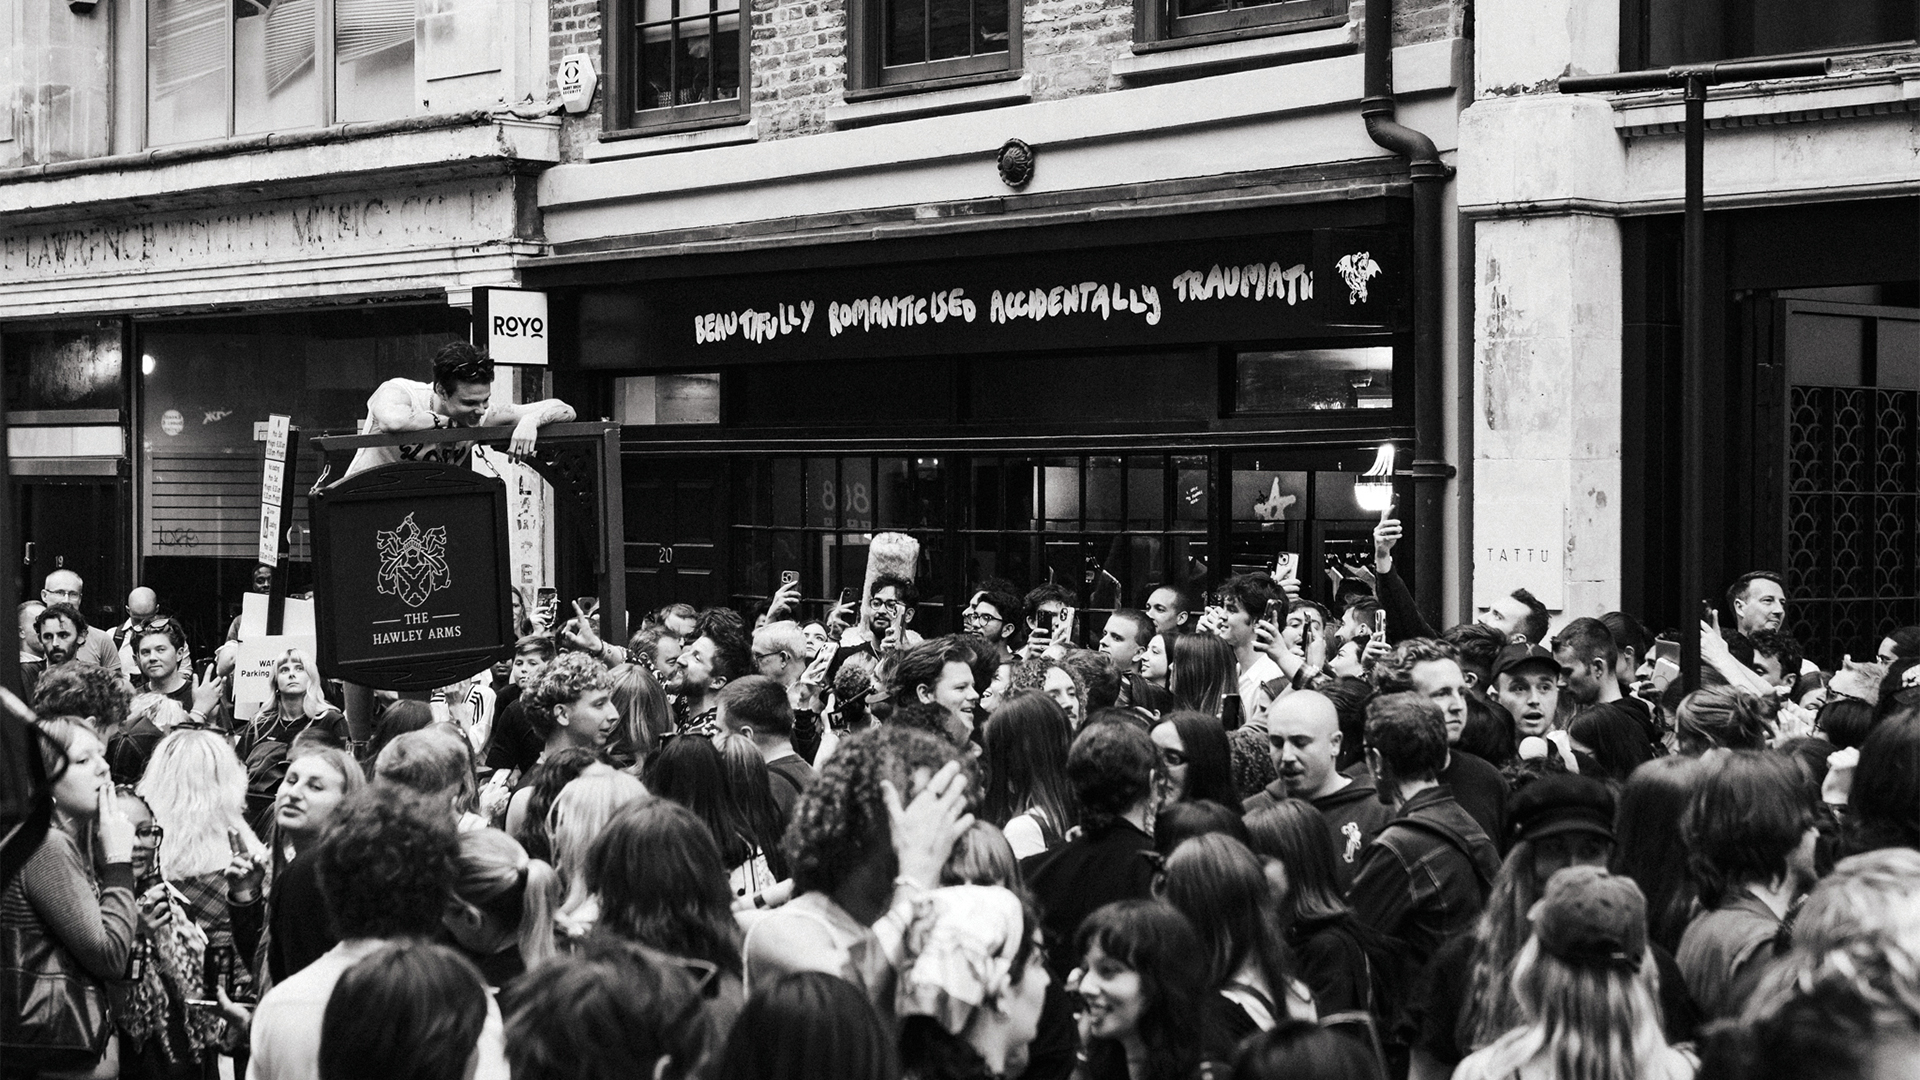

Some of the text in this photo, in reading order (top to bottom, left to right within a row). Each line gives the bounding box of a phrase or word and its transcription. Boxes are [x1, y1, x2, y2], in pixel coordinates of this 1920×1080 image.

[695, 261, 1314, 344] BEAUTIFULLY ROMANTICISED ACCIDENTALLY TRAUMATI
[493, 315, 543, 338] ROYO
[55, 555, 64, 568] 19
[659, 547, 673, 563] 20
[1487, 547, 1548, 562] TATTU
[404, 612, 429, 625] THE
[373, 626, 462, 645] HAWLEY ARMS
[241, 670, 270, 678] Parking
